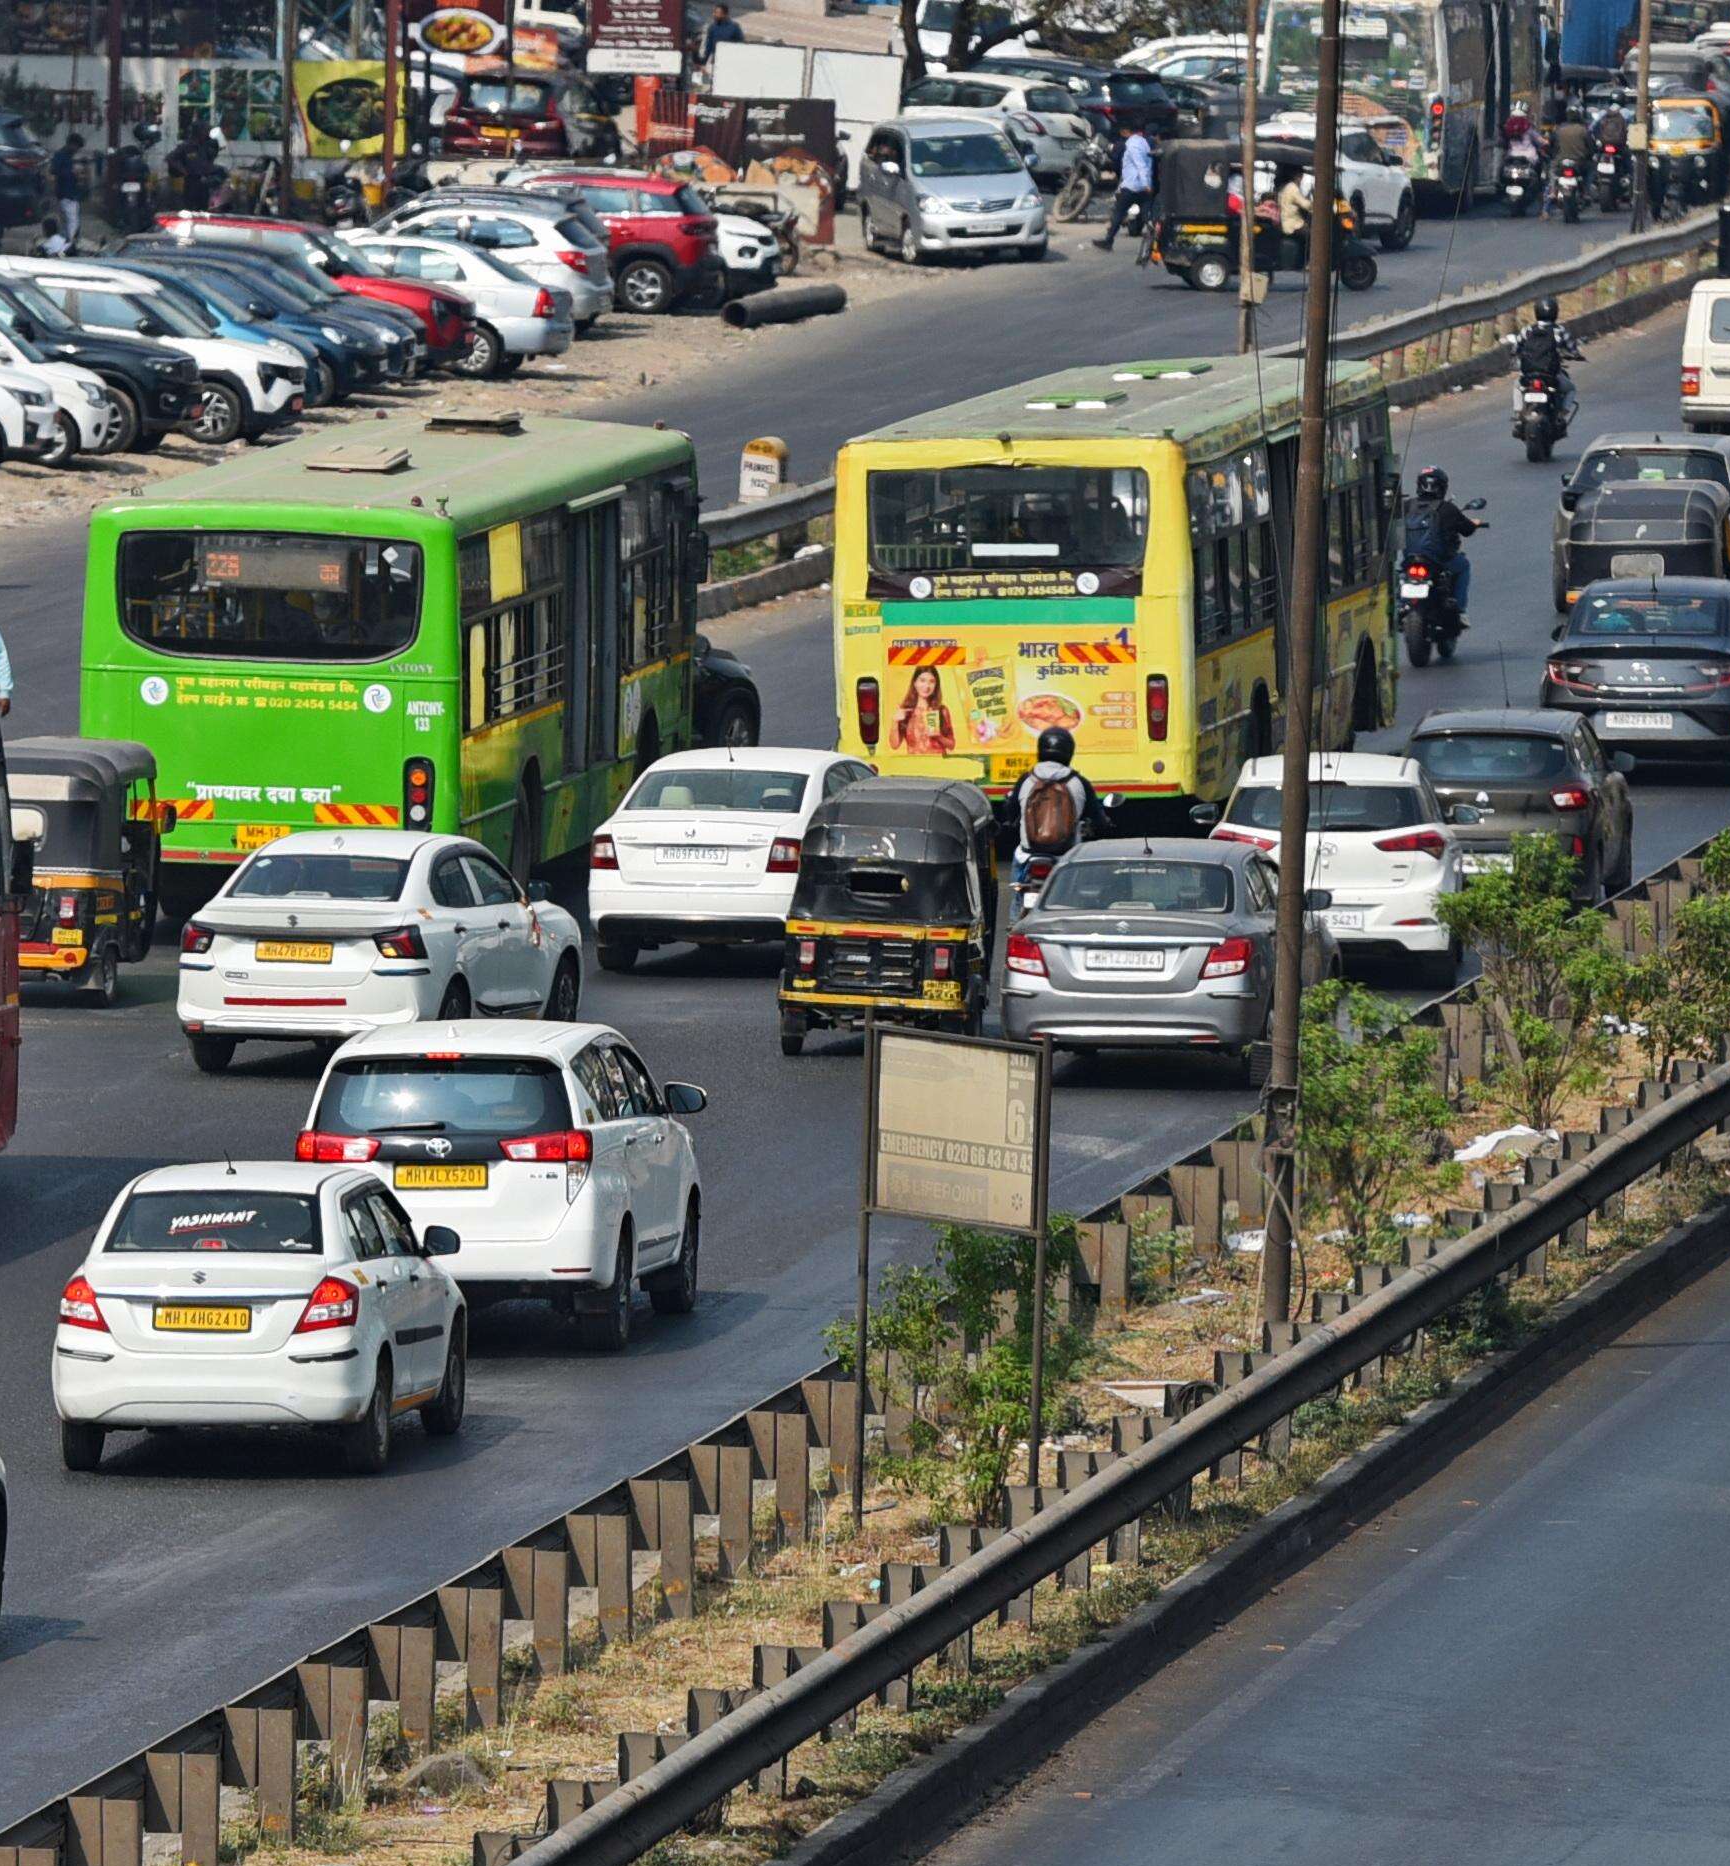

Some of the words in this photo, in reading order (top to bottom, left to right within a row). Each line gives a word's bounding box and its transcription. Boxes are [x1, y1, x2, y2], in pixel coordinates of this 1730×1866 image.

[268, 698, 292, 708] 020
[294, 699, 325, 709] 2454
[327, 699, 358, 711] 5454
[414, 717, 431, 732] 133
[1008, 1098, 1035, 1145] 6
[880, 1132, 945, 1160] EMERGENCY
[946, 1142, 969, 1163] 020
[970, 1145, 986, 1166] 66
[987, 1148, 1002, 1169] 43
[1003, 1151, 1018, 1172] 43
[170, 1210, 258, 1230] YASHWANT
